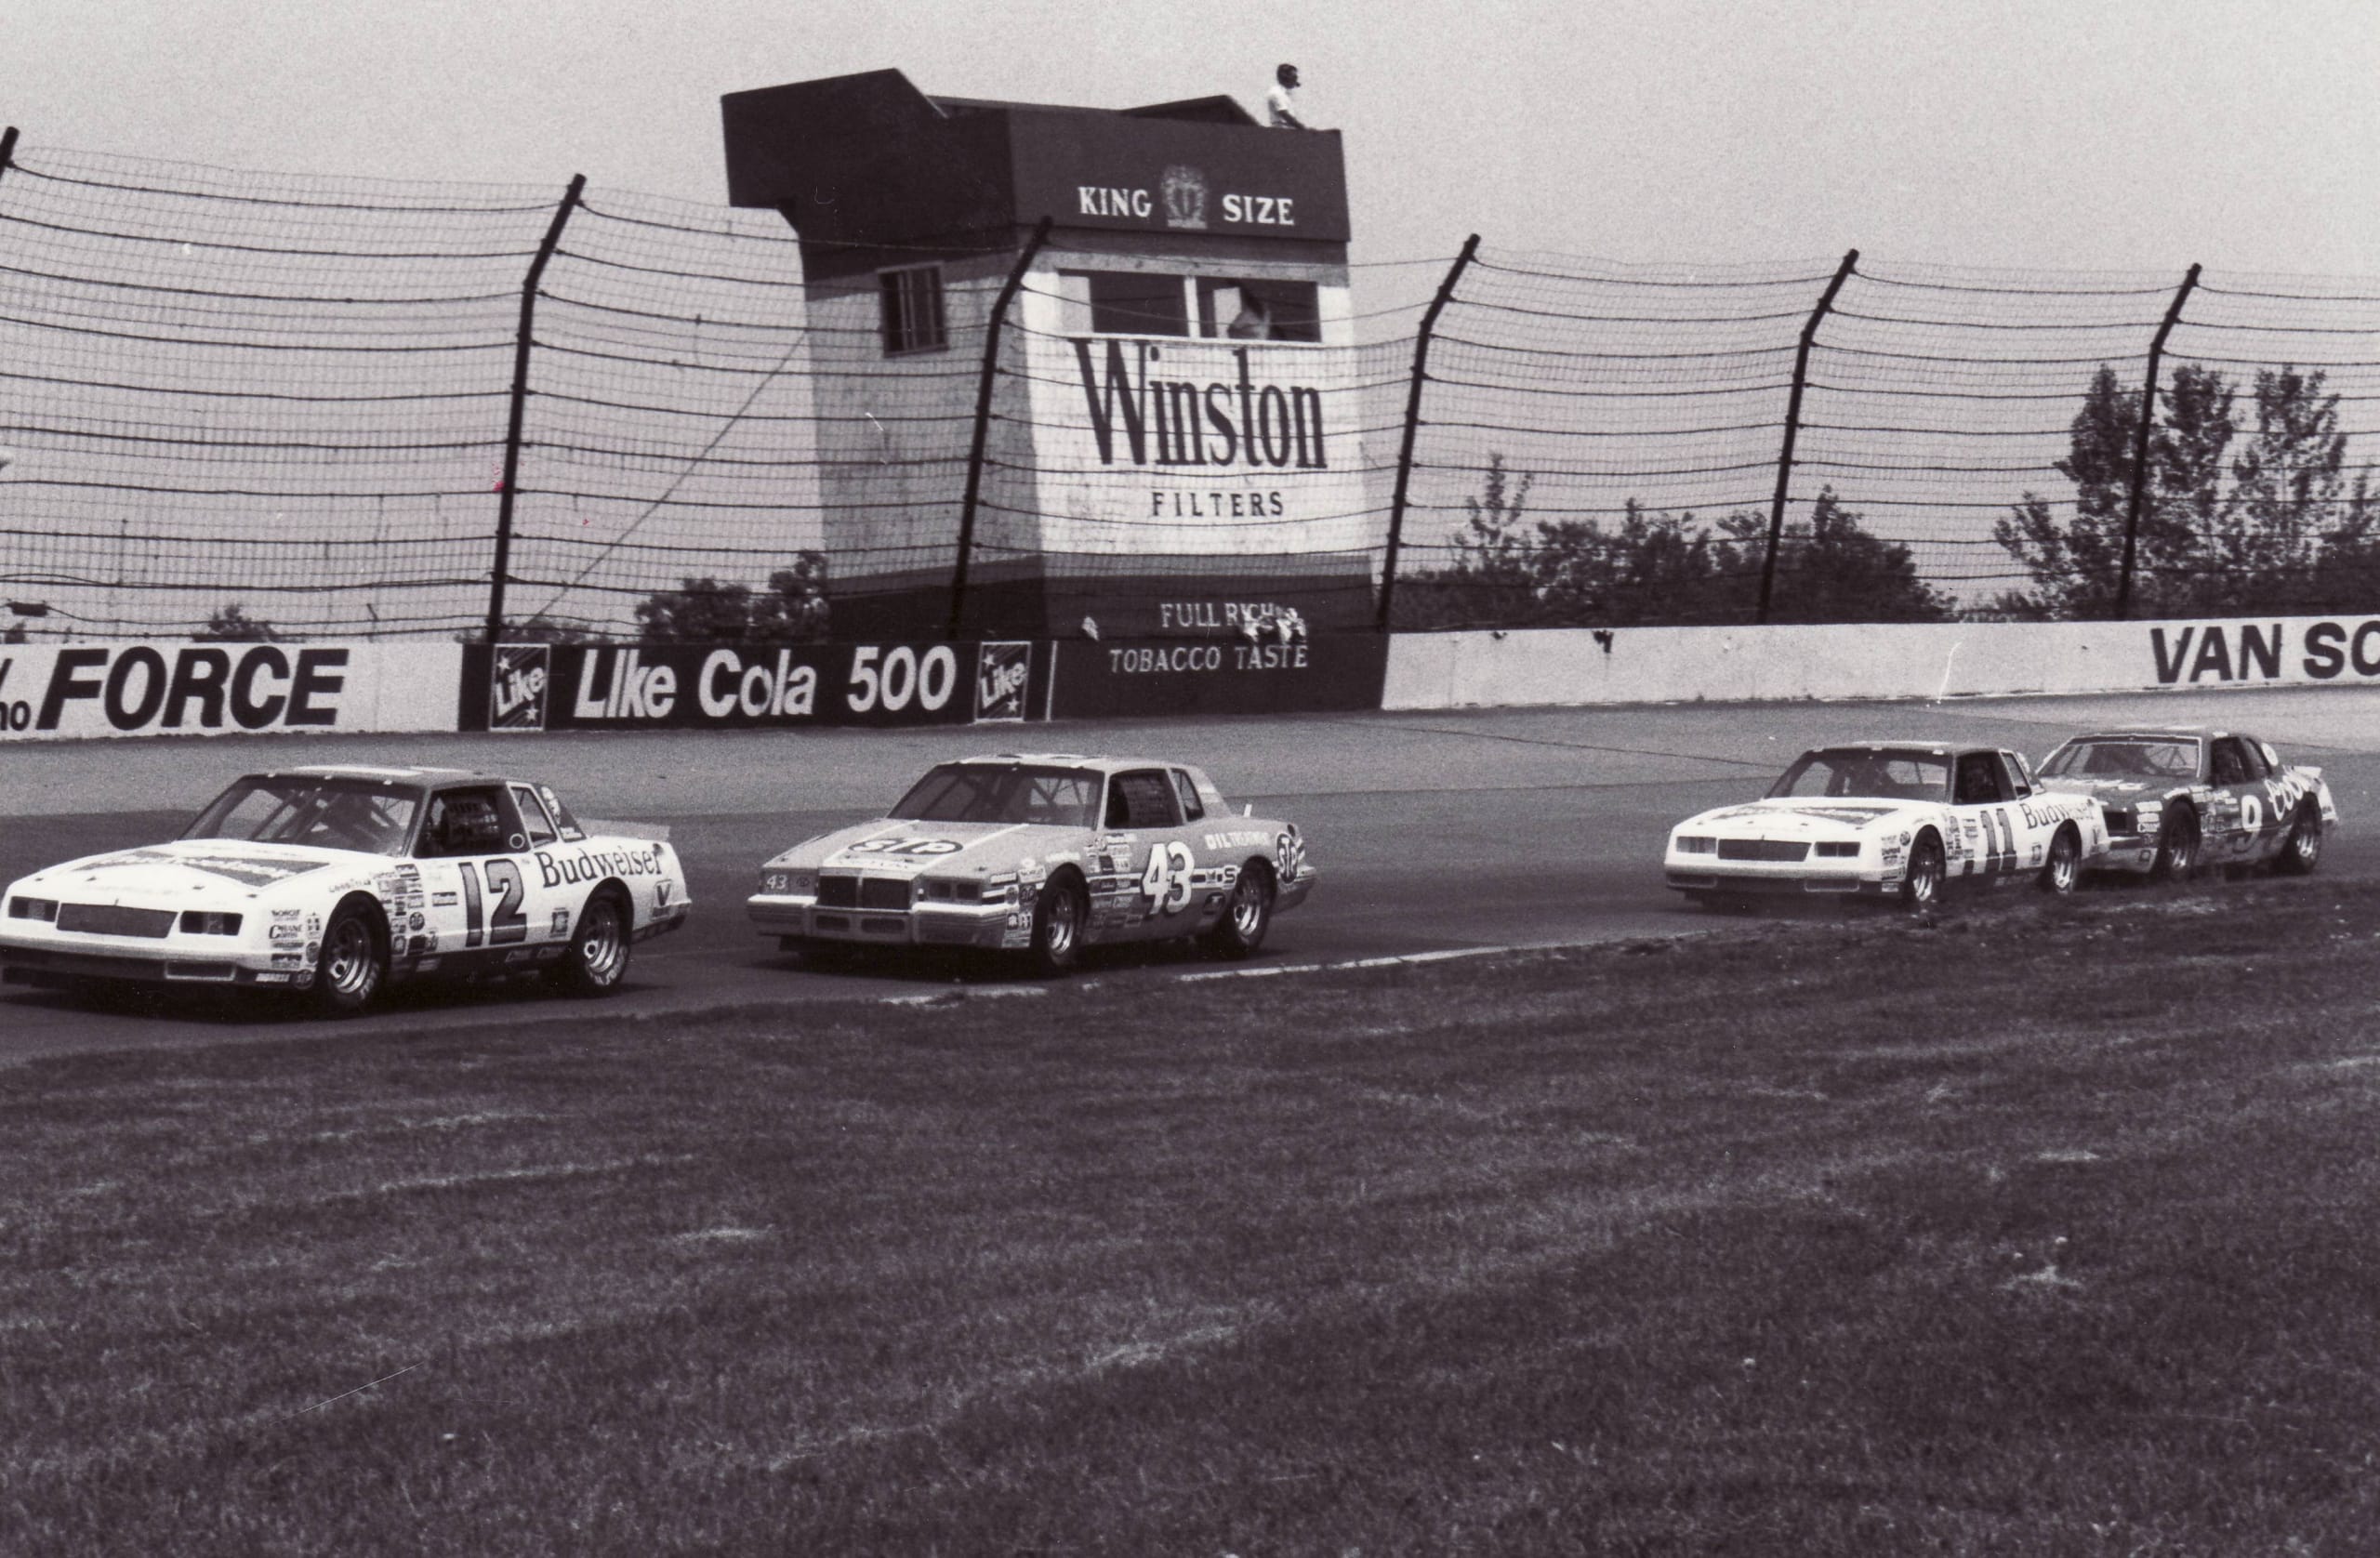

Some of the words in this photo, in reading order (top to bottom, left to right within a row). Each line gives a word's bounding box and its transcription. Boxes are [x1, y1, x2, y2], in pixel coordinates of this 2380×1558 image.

[1078, 186, 1152, 218] KING
[1223, 193, 1294, 225] SIZE
[1067, 337, 1328, 469] Winston
[1151, 492, 1284, 516] FILTERS
[1160, 603, 1221, 627] FULL
[1110, 646, 1222, 673] TOBACCO
[1235, 643, 1308, 670] TASTE
[2149, 623, 2282, 683] VAN
[35, 646, 350, 731] FORCE
[496, 666, 547, 717] Like
[698, 648, 817, 719] Cola
[847, 645, 957, 713] 500
[981, 660, 1026, 708] Like
[850, 838, 959, 854] STP
[1278, 836, 1297, 879] STP
[1980, 808, 2016, 872] 11
[534, 842, 663, 889] Budweiser
[766, 874, 788, 890] 43
[1142, 841, 1196, 916] 43
[458, 858, 527, 947] 12
